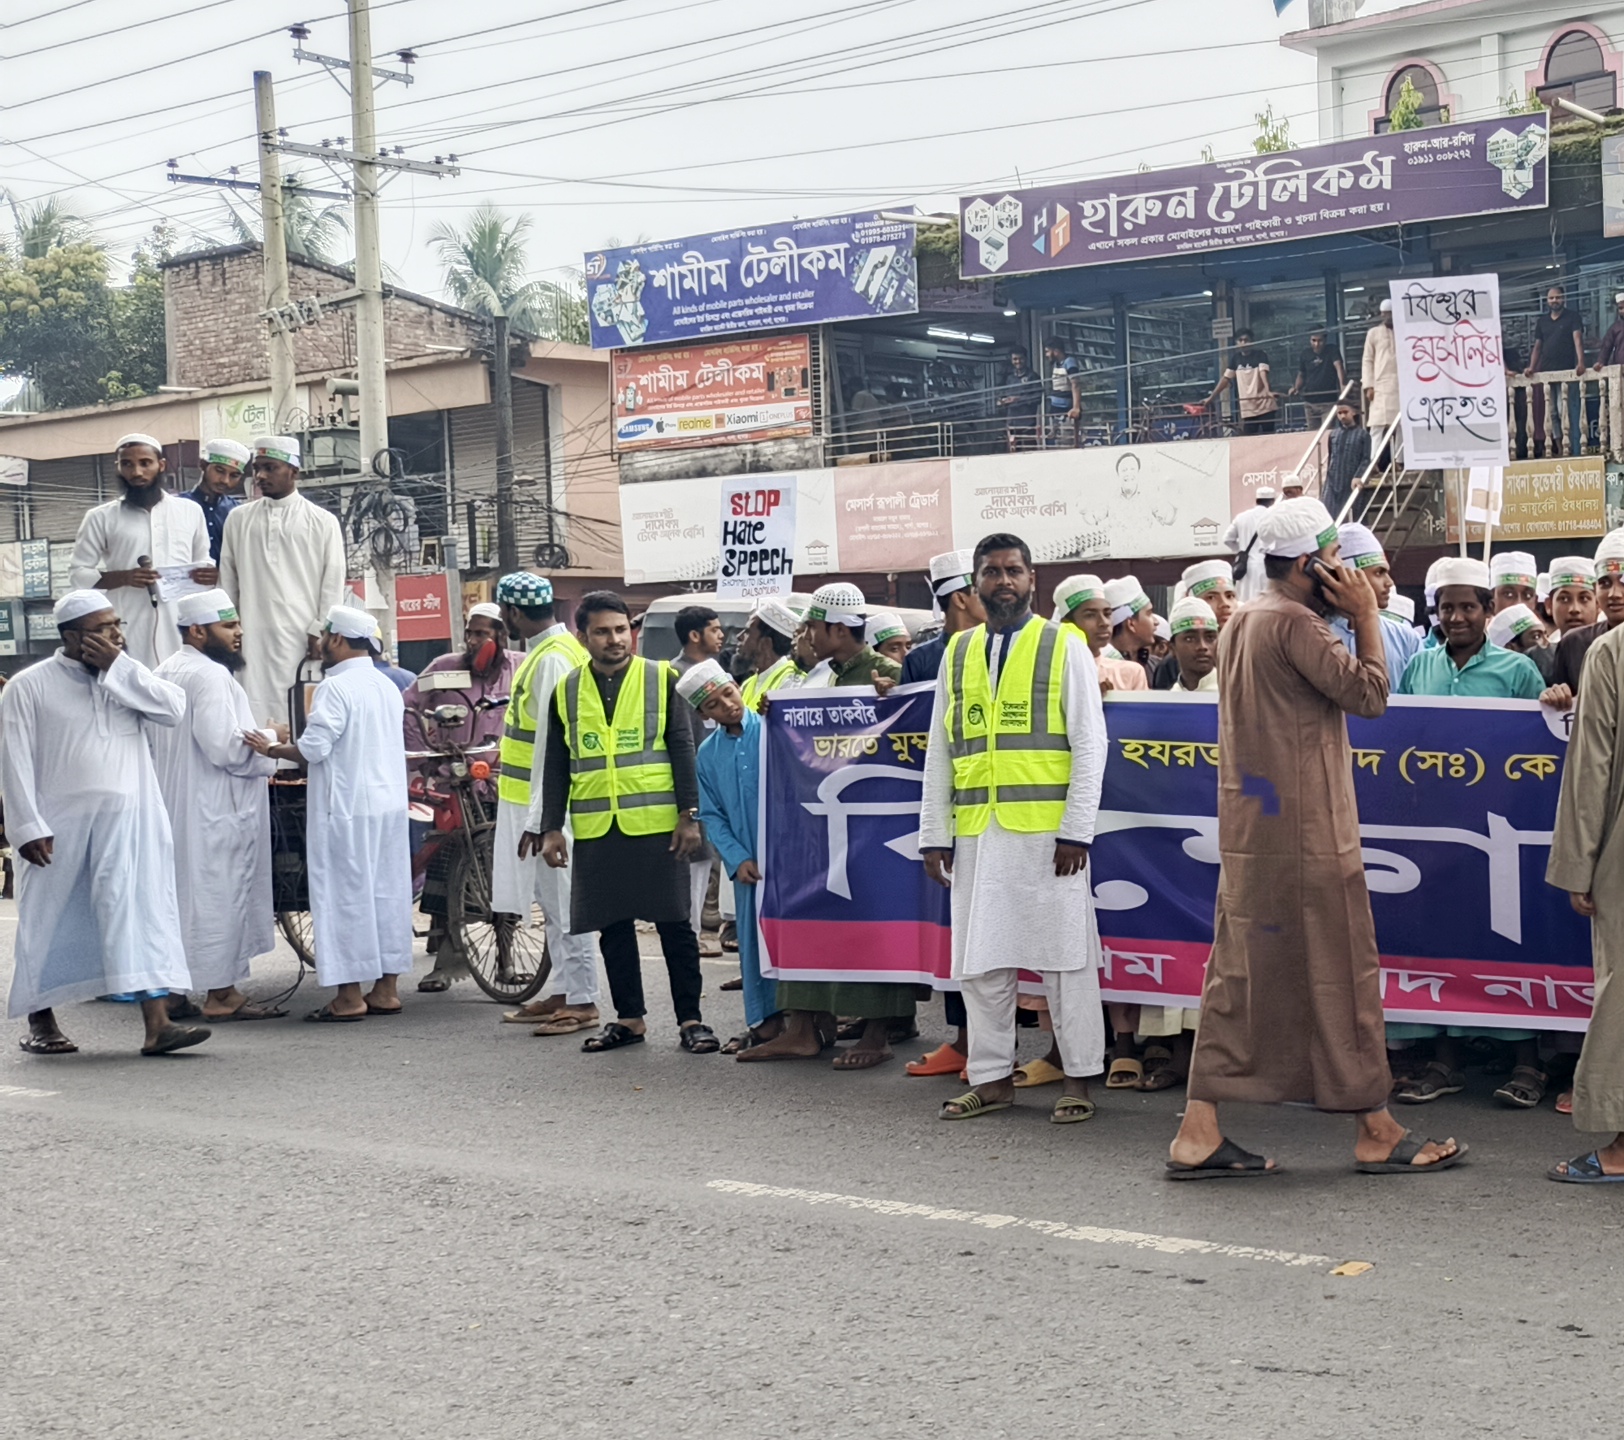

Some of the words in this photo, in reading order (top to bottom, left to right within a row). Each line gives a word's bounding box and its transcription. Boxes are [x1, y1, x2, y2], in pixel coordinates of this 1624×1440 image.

[1403, 131, 1477, 154] হারুন-আর-রশিদ
[1077, 187, 1199, 237] হারুন
[1207, 150, 1397, 223] টেলিকম
[1117, 237, 1138, 247] সকল
[1140, 233, 1164, 245] প্রকার
[1166, 227, 1212, 241] মোবাইলের
[1244, 216, 1281, 231] পাইকারী
[1284, 216, 1293, 225] ও
[1320, 208, 1346, 220] বিক্রয়
[1349, 205, 1367, 215] করা
[649, 252, 731, 301] শামীম
[740, 236, 851, 289] টেলীকম
[682, 304, 698, 314] kinds
[698, 302, 706, 311] of
[706, 299, 728, 311] mobile
[728, 299, 744, 310] parts
[778, 291, 791, 301] and
[792, 288, 816, 300] retailer
[1401, 282, 1489, 325] বিশ্বের
[1404, 319, 1502, 388] মুসলিম
[637, 363, 690, 394] শামীম
[695, 357, 766, 389] টেলীকম
[620, 422, 651, 434] SAMSUNG
[678, 418, 711, 430] realme
[726, 411, 759, 426] Xiaomi
[1242, 465, 1278, 487] মেসার্স
[991, 494, 1016, 508] দামে
[1017, 494, 1035, 506] কম
[1009, 505, 1038, 519] অনেক
[1040, 500, 1067, 517] বেশি
[1562, 497, 1600, 512] ঔষধালয়
[683, 523, 705, 539] বেশি
[722, 520, 767, 546] Hate
[783, 705, 825, 728] নারায়ে
[826, 699, 879, 725] তাকবীর
[813, 733, 882, 759] ভারতে
[1399, 745, 1485, 787] (সঃ)
[1504, 751, 1560, 782] কে
